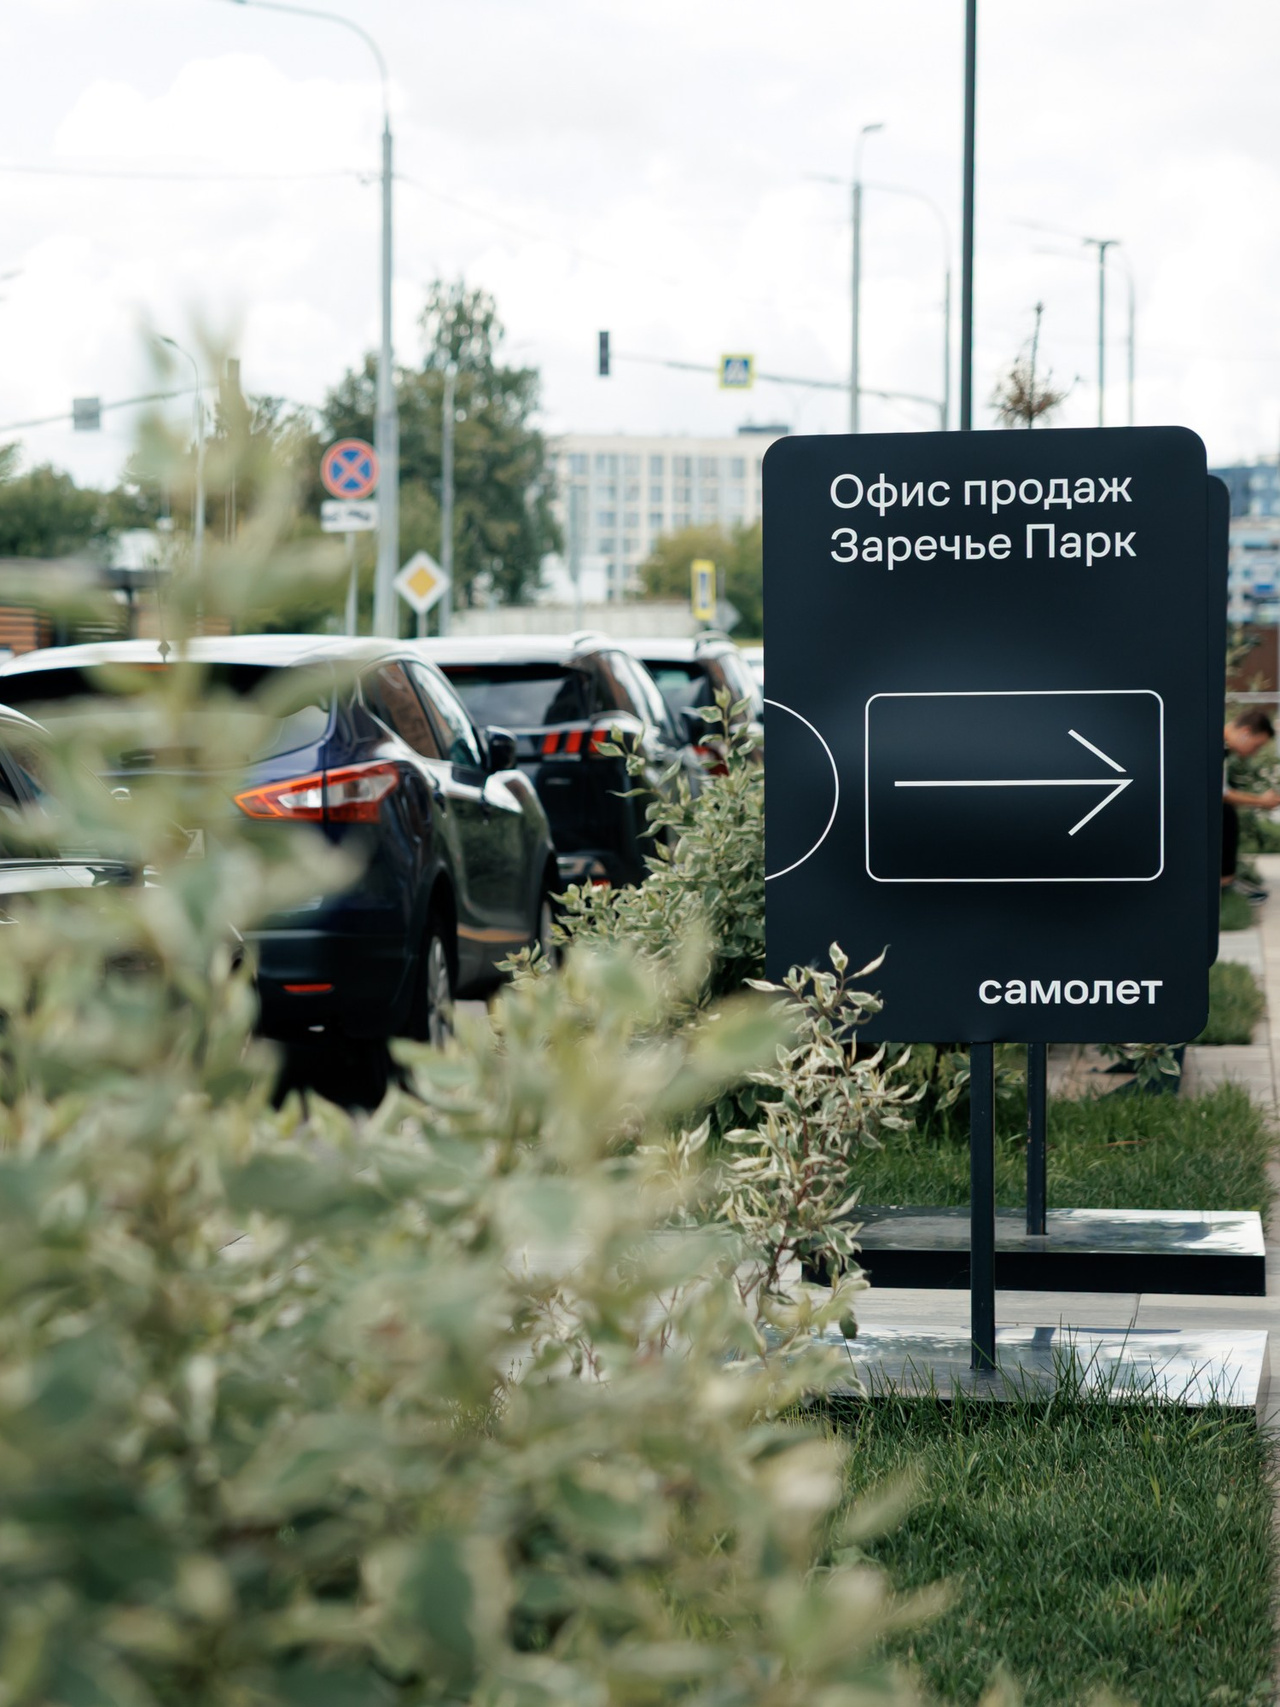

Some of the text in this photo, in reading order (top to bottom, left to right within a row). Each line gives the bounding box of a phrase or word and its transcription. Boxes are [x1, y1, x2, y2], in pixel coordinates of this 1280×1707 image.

[830, 473, 1133, 516] Офис продаж
[830, 523, 1137, 570] Заречье Парк
[978, 979, 1163, 1004] самолет
